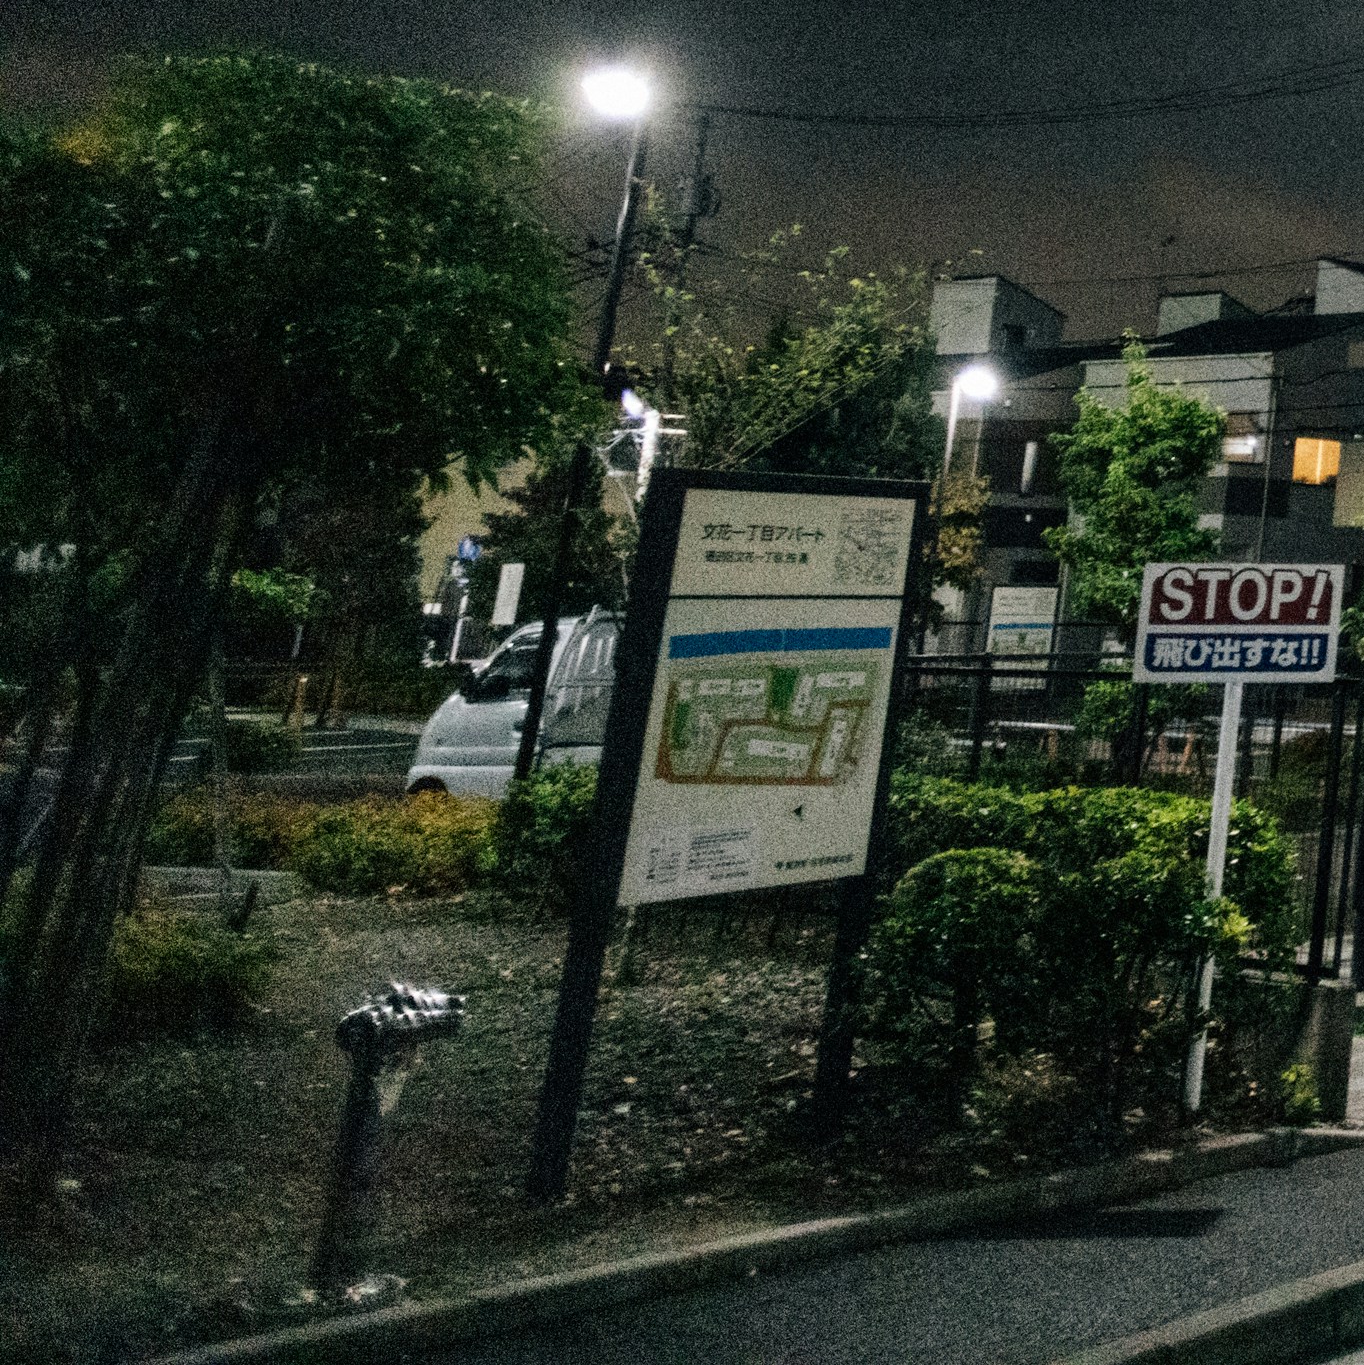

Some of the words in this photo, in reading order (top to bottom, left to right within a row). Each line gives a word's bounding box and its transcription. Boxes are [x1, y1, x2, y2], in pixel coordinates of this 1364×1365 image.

[702, 523, 825, 542] 文花一丁目アパート
[1159, 567, 1330, 621] STOP!
[1152, 637, 1320, 668] 飛び出すな!!
